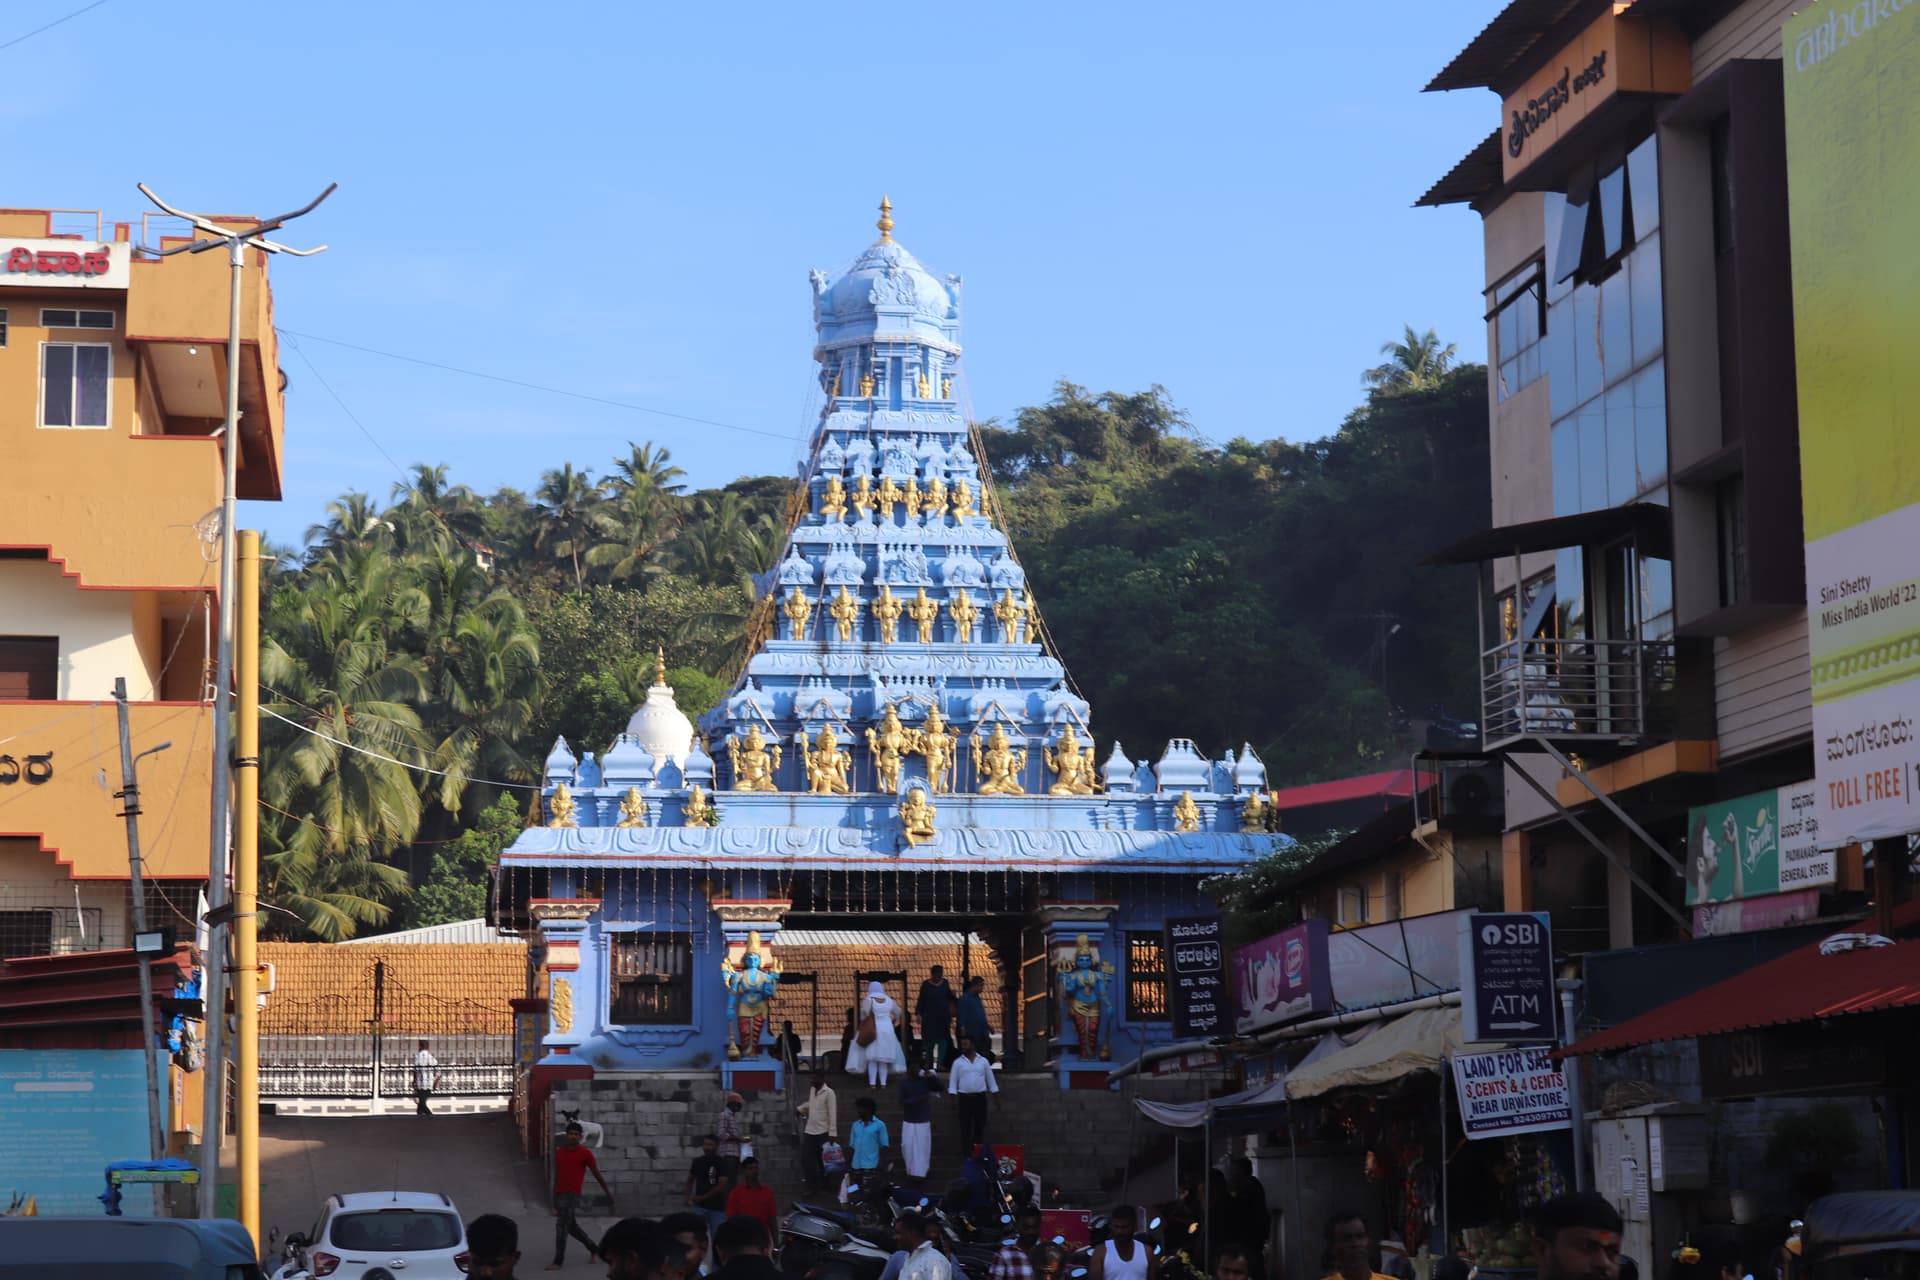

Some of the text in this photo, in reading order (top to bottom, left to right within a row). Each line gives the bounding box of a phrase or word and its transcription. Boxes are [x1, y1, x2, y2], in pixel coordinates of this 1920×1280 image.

[6, 245, 110, 274] ನಿವಾಸ
[1820, 576, 1871, 604] Sini Shetty
[1821, 610, 1843, 630] Miss
[1844, 600, 1869, 622] India
[1870, 587, 1900, 613] World
[1826, 713, 1913, 762] ಮಂಗಳೂರು:
[1828, 777, 1862, 810] TOLL
[1865, 767, 1901, 802] FREE
[1781, 862, 1829, 883] GENERAL STORE
[1503, 923, 1540, 945] SBI
[1491, 994, 1540, 1015] ATM
[1462, 1049, 1551, 1079] LAND FOR SAL
[1730, 1037, 1763, 1077] SBI
[1465, 1073, 1564, 1099] 3 CENTS & 4 CENTS
[1471, 1091, 1564, 1115] NEAR URWASTORE
[1471, 1119, 1500, 1129] Contact
